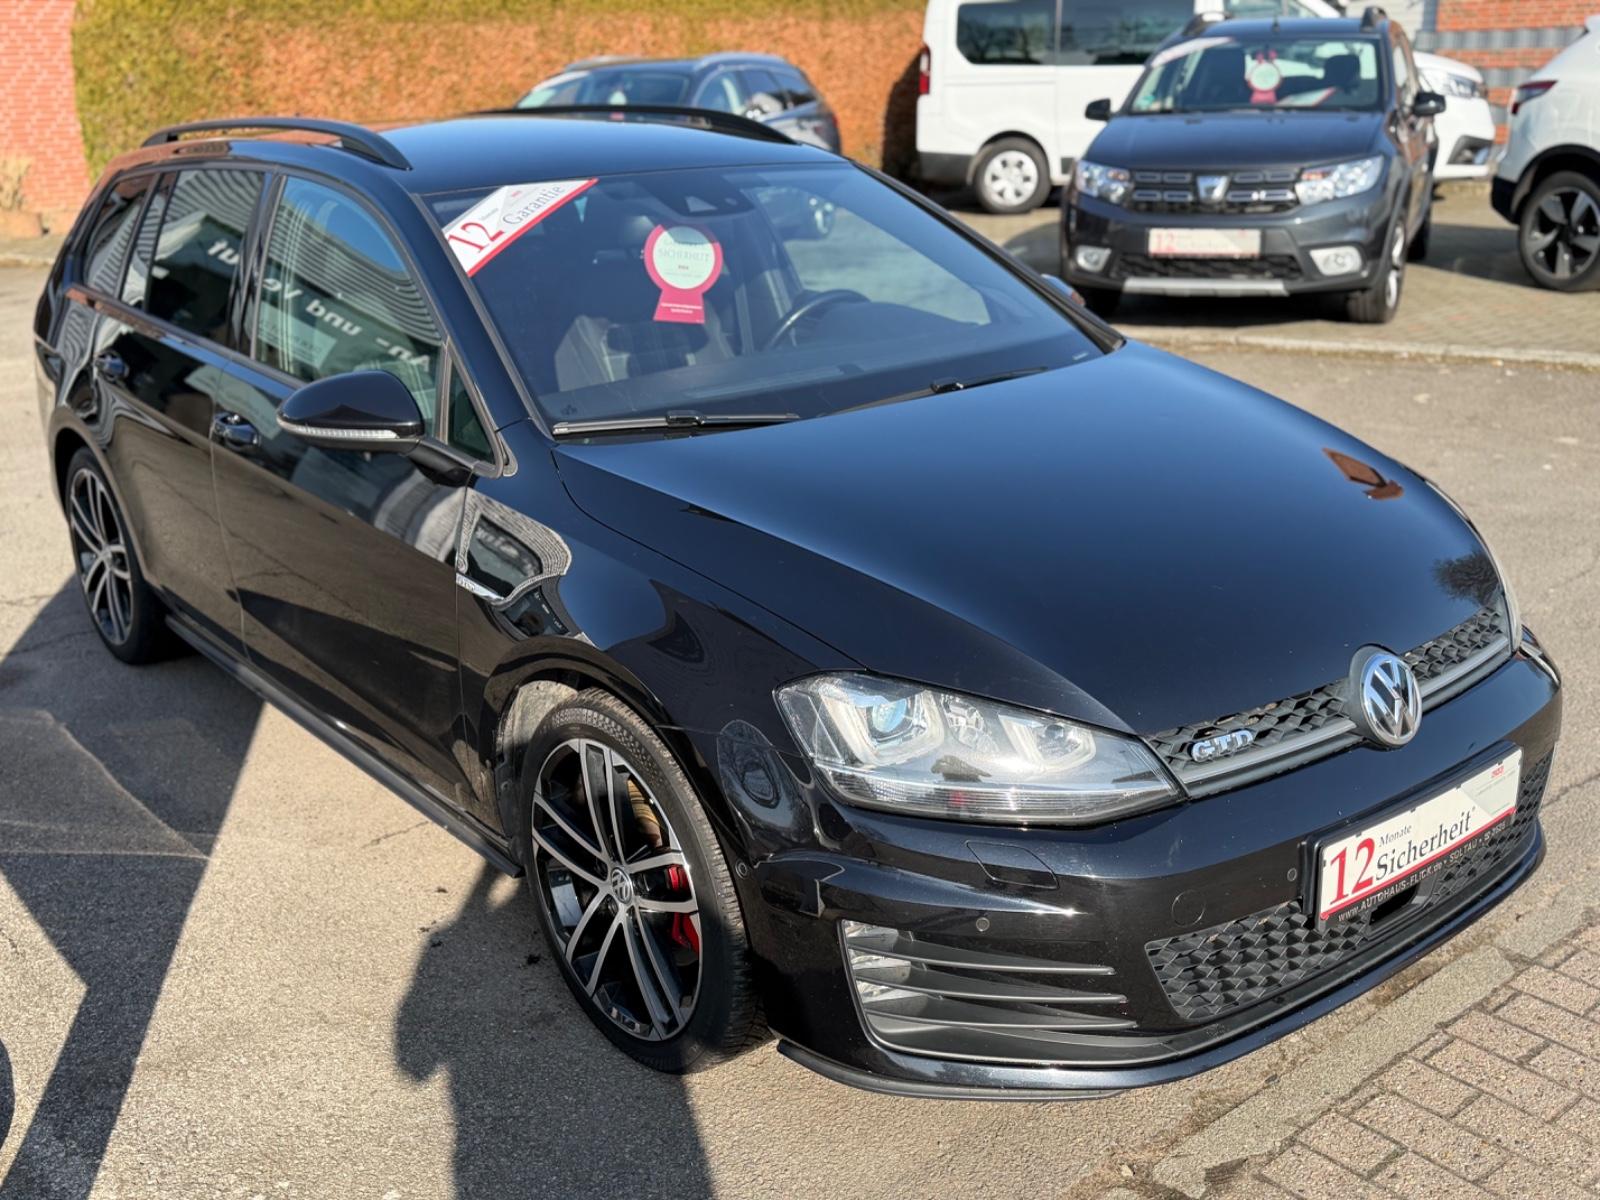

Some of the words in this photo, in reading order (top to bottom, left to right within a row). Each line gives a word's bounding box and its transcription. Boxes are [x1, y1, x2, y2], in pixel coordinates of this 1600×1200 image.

[502, 184, 565, 226] Garantie
[447, 221, 505, 254] 12
[1191, 729, 1254, 763] GTD
[1375, 810, 1471, 882] Sicherheit
[1379, 823, 1412, 847] Monate
[1330, 837, 1375, 905] 12
